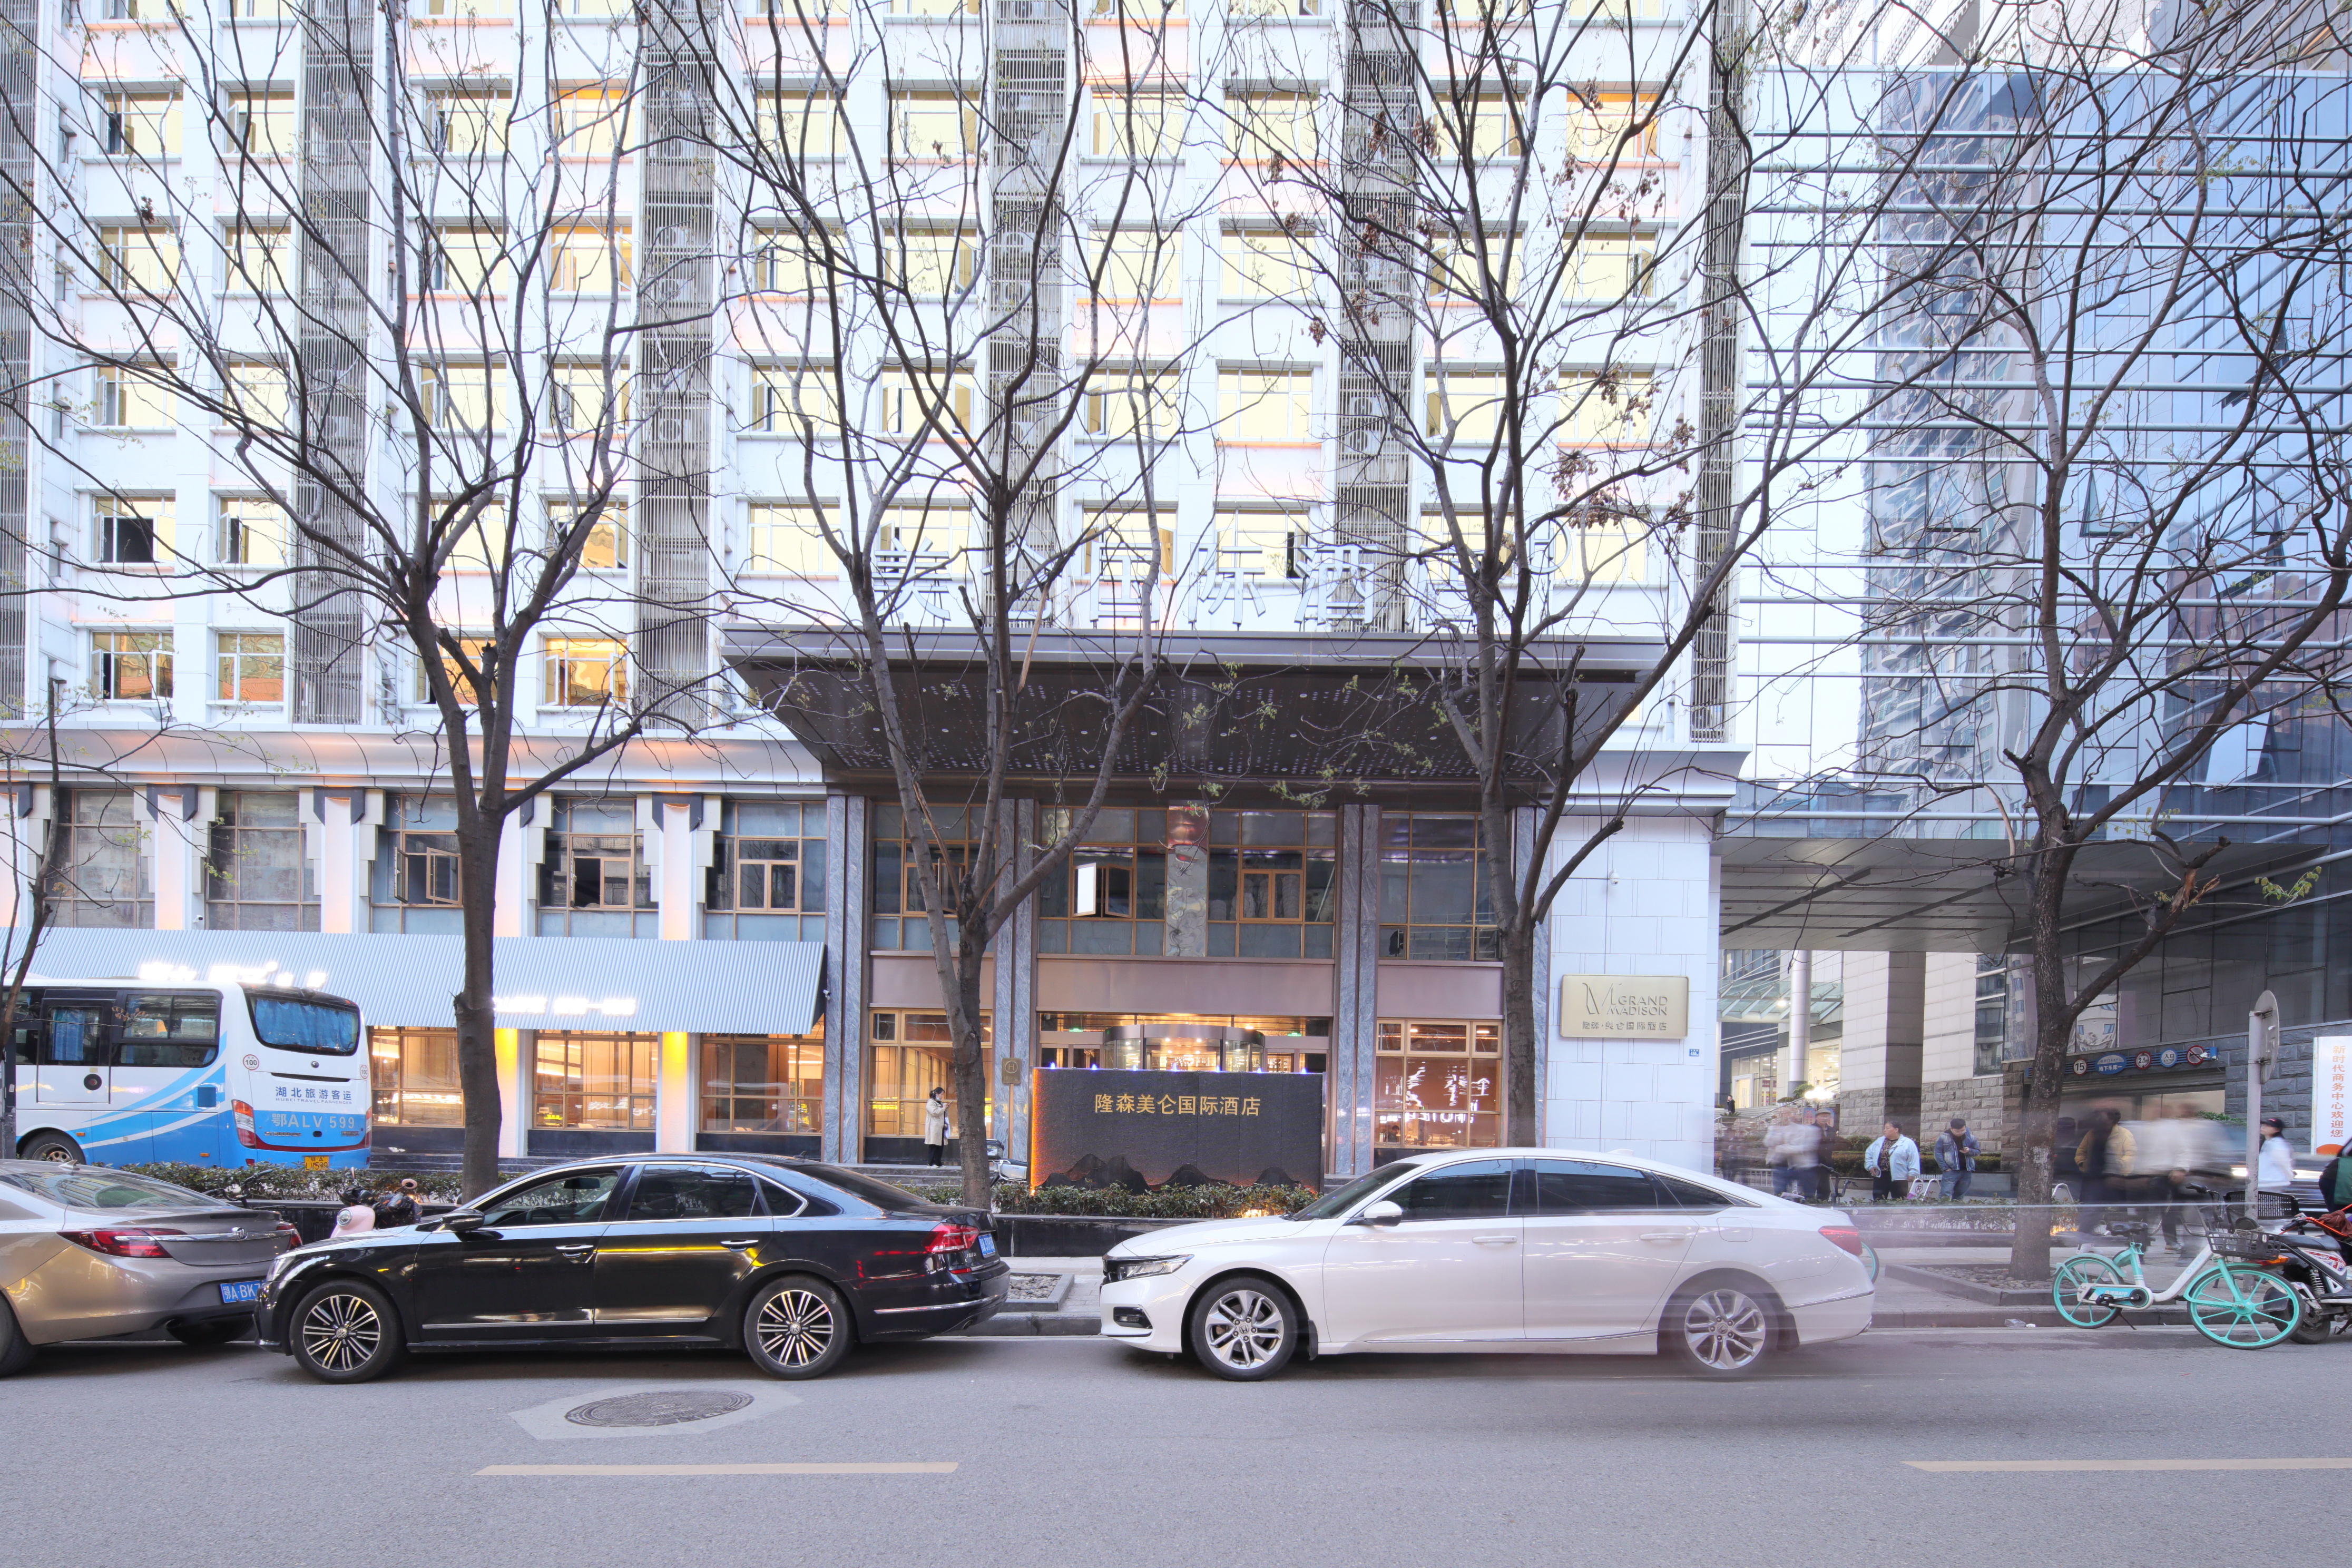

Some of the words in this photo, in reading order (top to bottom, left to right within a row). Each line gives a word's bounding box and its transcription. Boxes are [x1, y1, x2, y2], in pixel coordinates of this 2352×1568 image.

[1619, 995, 1668, 1006] GRAND
[1607, 1006, 1667, 1015] MADISON
[2075, 1062, 2084, 1071] 15
[276, 1086, 351, 1101] 湖北旅游客运
[2330, 1045, 2346, 1138] 新时代商务中心欢迎您
[1095, 1093, 1261, 1116] 隆森美仑国际酒店
